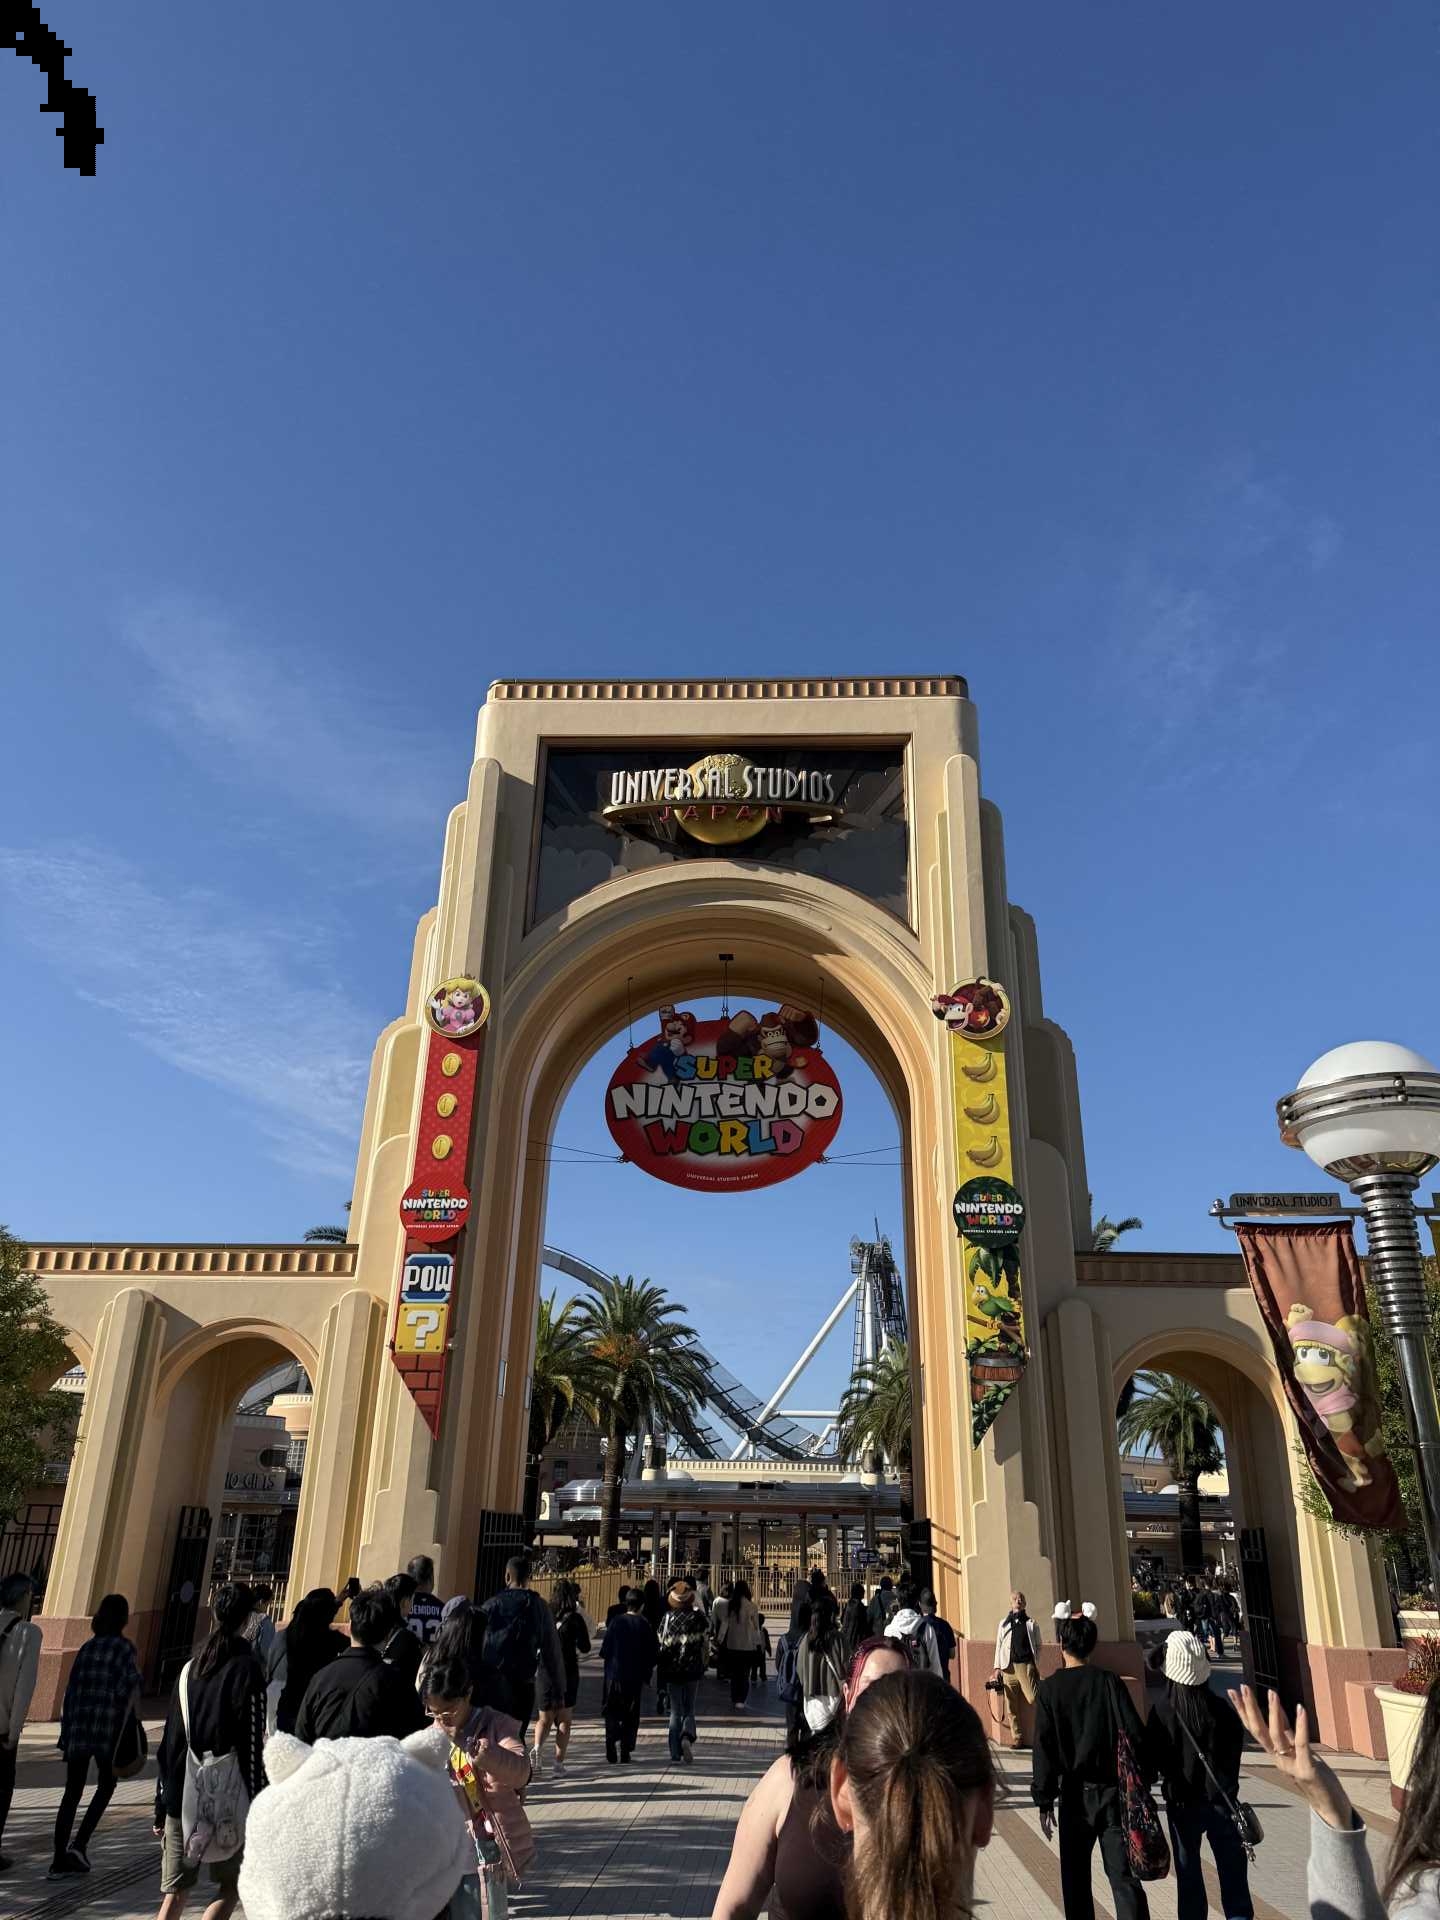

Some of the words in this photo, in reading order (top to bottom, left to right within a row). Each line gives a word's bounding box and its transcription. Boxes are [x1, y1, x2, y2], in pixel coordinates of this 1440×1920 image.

[611, 768, 735, 805] UNIVERSAL
[742, 766, 834, 803] STUDIOS
[659, 805, 784, 824] JAPAN
[675, 1054, 776, 1082] SUPER
[610, 1082, 840, 1120] NINTENDO
[644, 1119, 804, 1156] WORLD
[402, 1198, 468, 1210] NINTENDO
[973, 1193, 1003, 1202] SUPER
[1235, 1196, 1287, 1208] UNIVERSAL
[955, 1202, 1023, 1214] NINTENDO
[966, 1214, 1013, 1225] WORLD
[402, 1265, 454, 1292] POW
